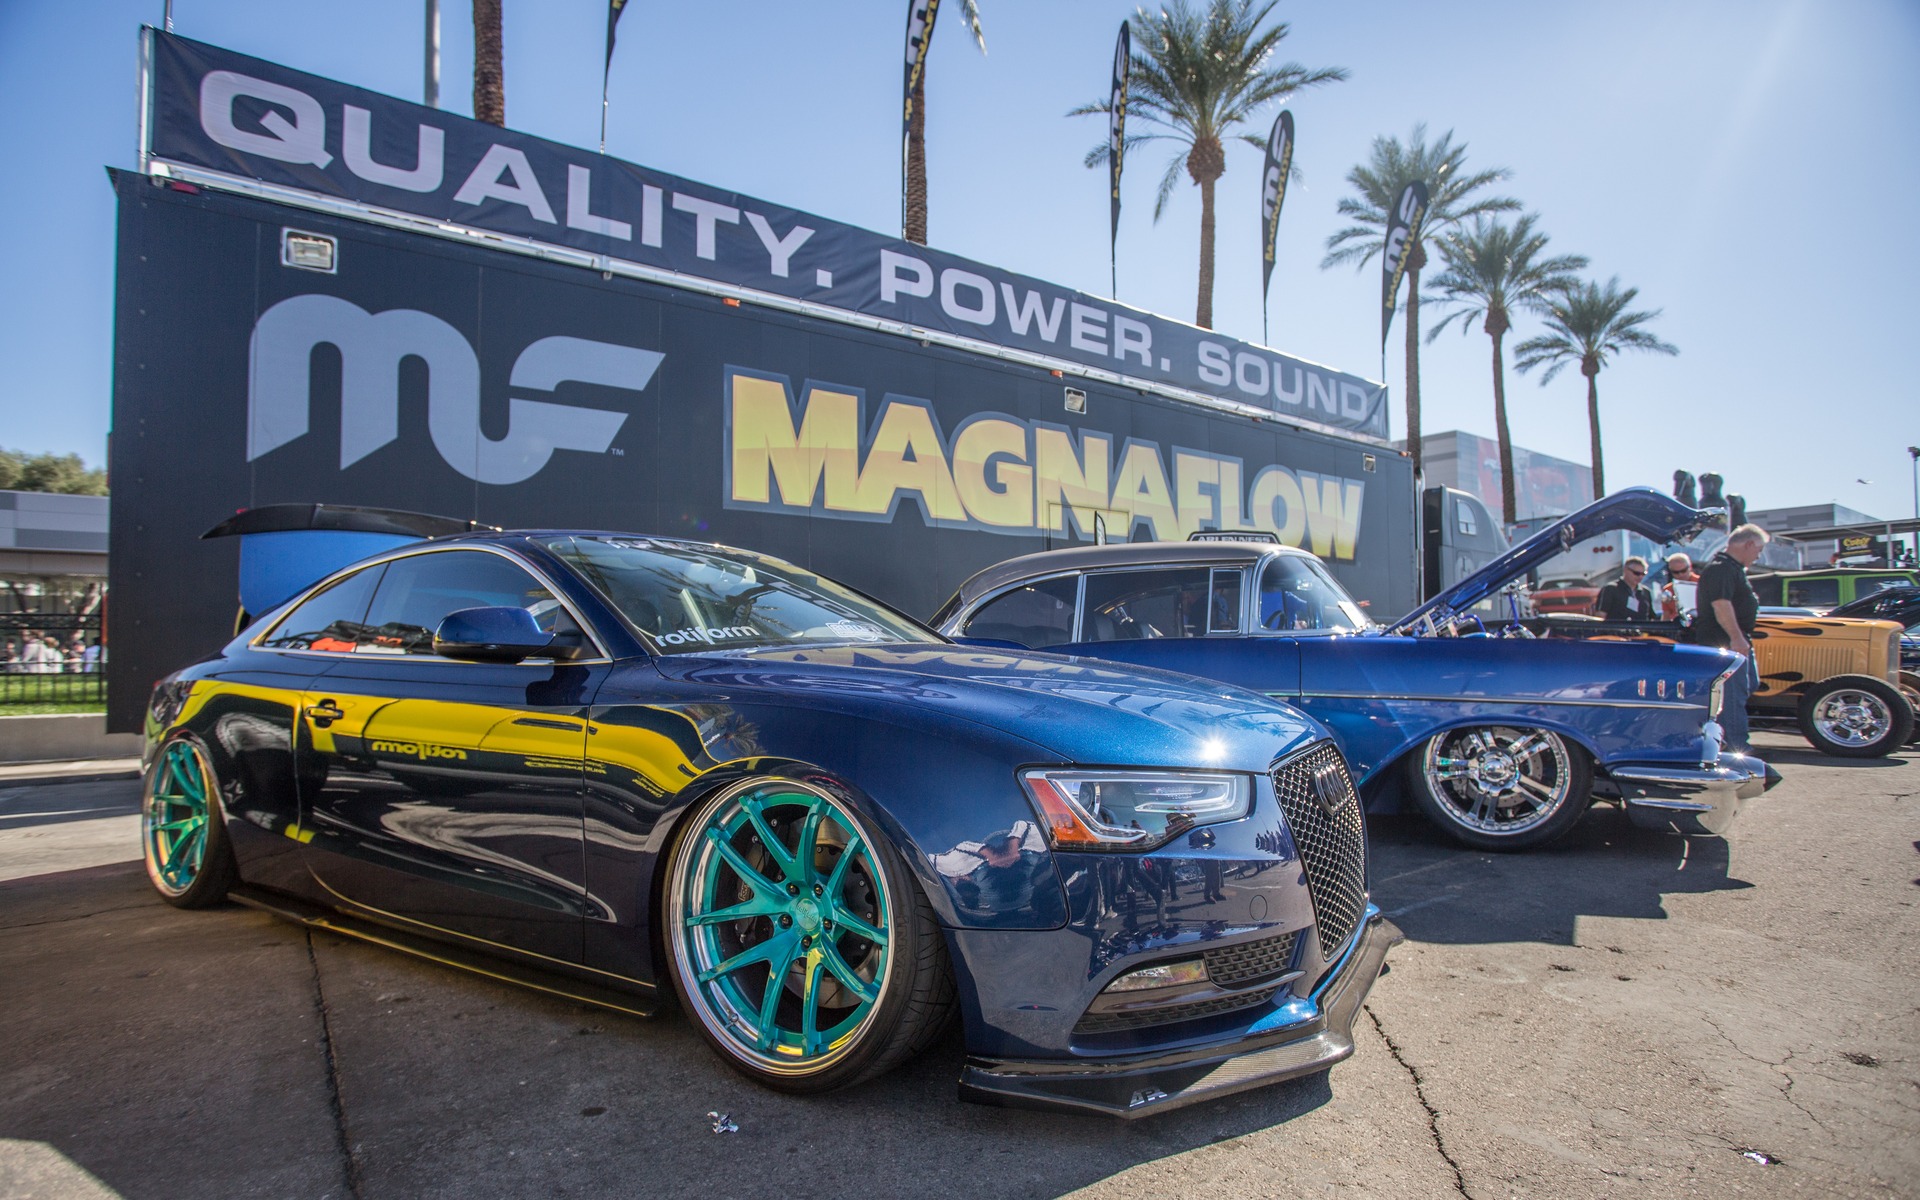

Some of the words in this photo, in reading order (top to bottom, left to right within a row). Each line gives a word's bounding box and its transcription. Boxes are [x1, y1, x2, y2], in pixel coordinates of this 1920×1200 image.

[200, 69, 833, 288] QUALITY.
[880, 248, 1170, 372] POWER.
[729, 370, 1364, 562] MAGNAFLOW
[654, 625, 761, 645] rotiform
